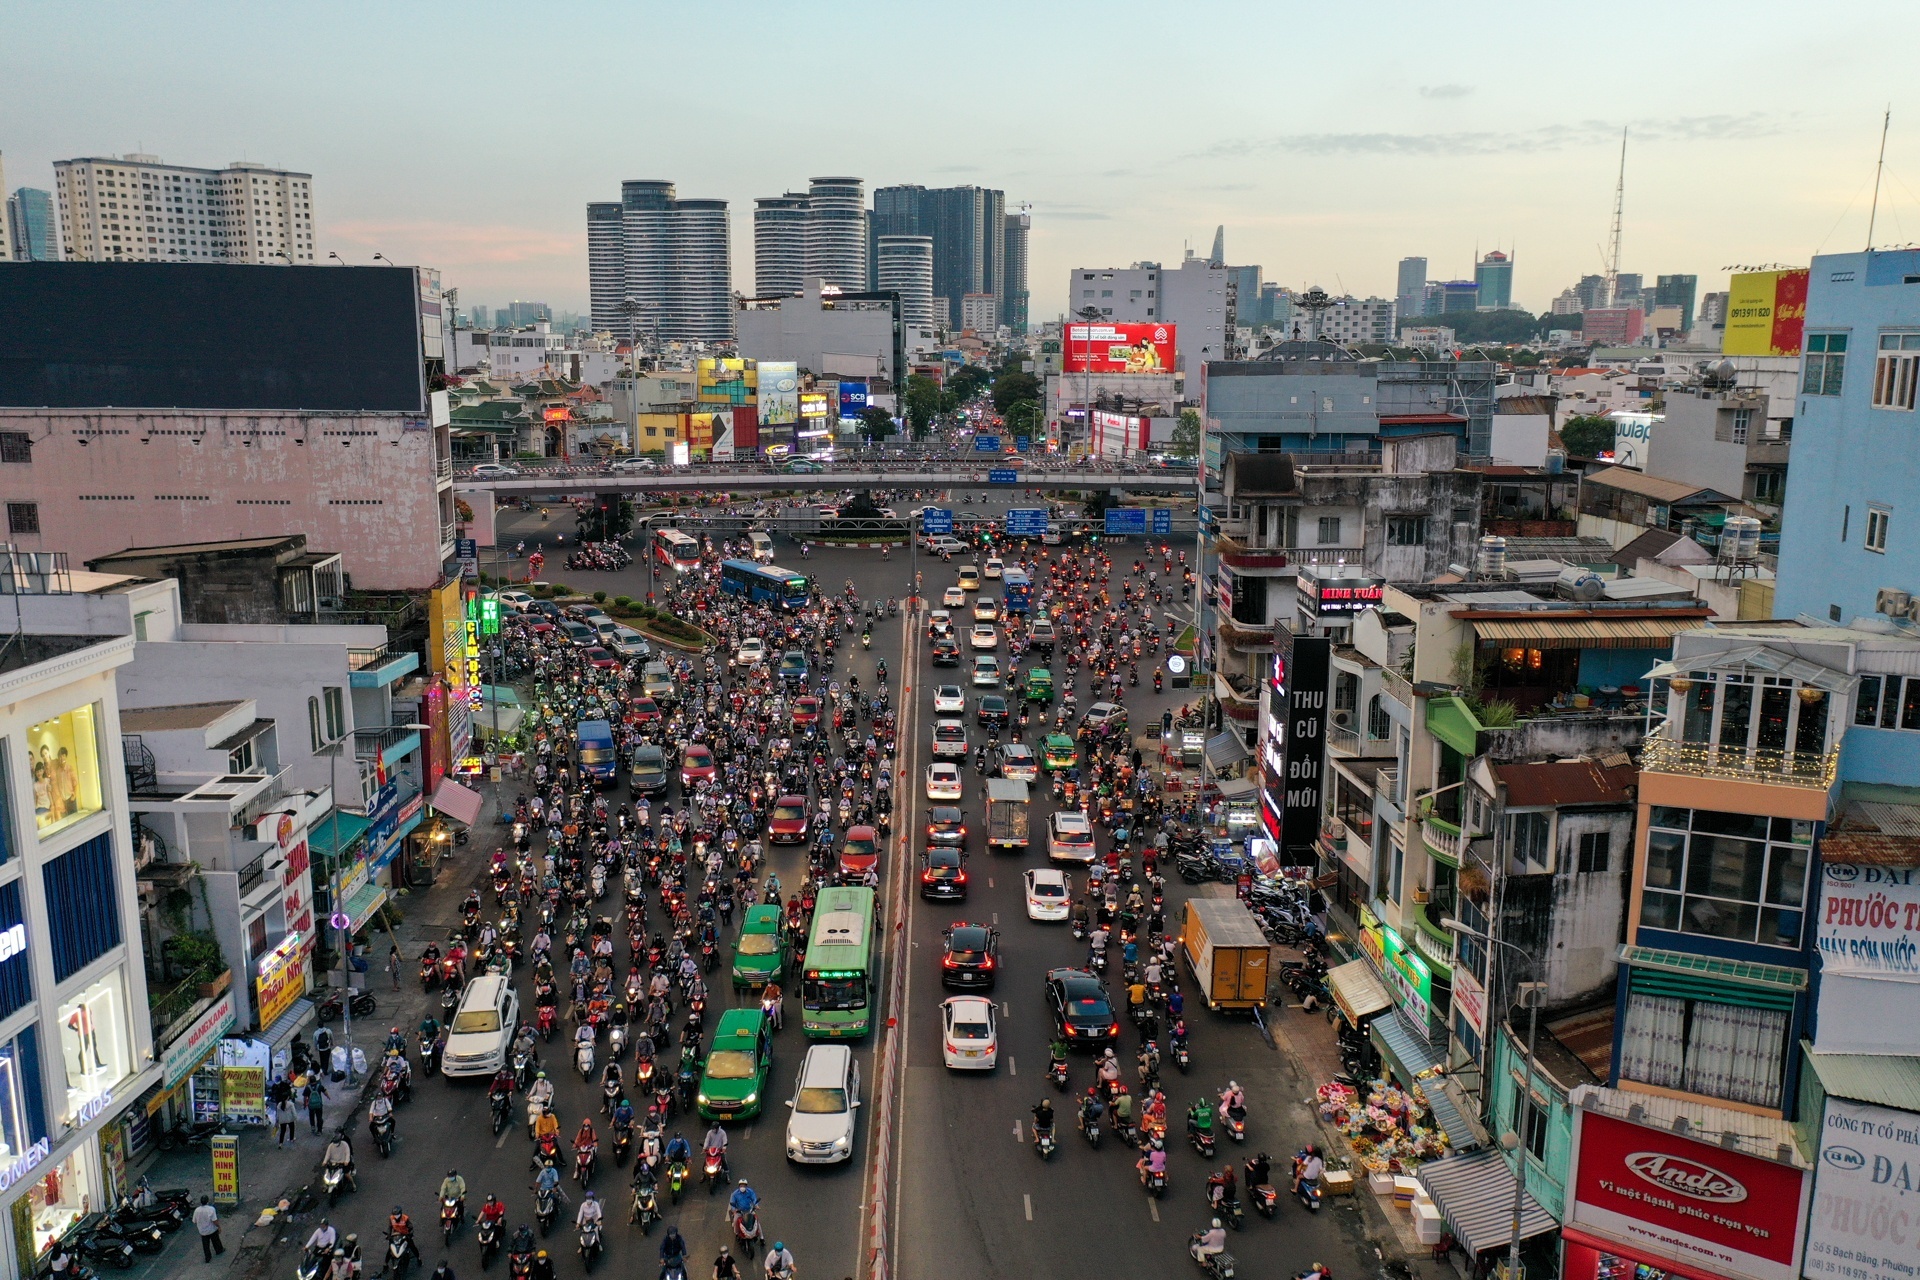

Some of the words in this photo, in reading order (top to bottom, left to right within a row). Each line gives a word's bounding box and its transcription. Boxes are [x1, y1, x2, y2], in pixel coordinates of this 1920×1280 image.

[1731, 308, 1746, 318] 0913
[1747, 308, 1757, 317] 911
[1758, 307, 1771, 317] 820
[1321, 588, 1352, 599] MINH
[1293, 691, 1324, 709] THU
[1296, 717, 1318, 739] CŨ
[1289, 753, 1317, 779] ĐỔI
[1286, 786, 1317, 808] MỚI
[1864, 867, 1912, 888] ĐẠI
[1825, 892, 1899, 929] PHƯỚC
[1881, 934, 1919, 973] NƯỚC
[77, 1087, 113, 1128] KIDS
[1828, 1113, 1858, 1133] CÔNG
[1861, 1121, 1875, 1135] TY
[1878, 1120, 1894, 1140] CỔ
[213, 1150, 234, 1159] CHỤP
[1831, 1151, 1858, 1165] BM
[1631, 1155, 1743, 1199] Andes
[1656, 1176, 1706, 1195] HELMET
[1616, 1186, 1641, 1201] một
[1643, 1192, 1675, 1210] hạnh
[1678, 1205, 1710, 1221] phúc
[1713, 1214, 1742, 1230] trọn
[1745, 1225, 1770, 1239] vẹn
[1813, 1240, 1826, 1253] Số
[1825, 1245, 1831, 1254] 5
[1833, 1246, 1854, 1260] Bạch
[1808, 1258, 1824, 1272] (08)
[1825, 1261, 1835, 1273] 35
